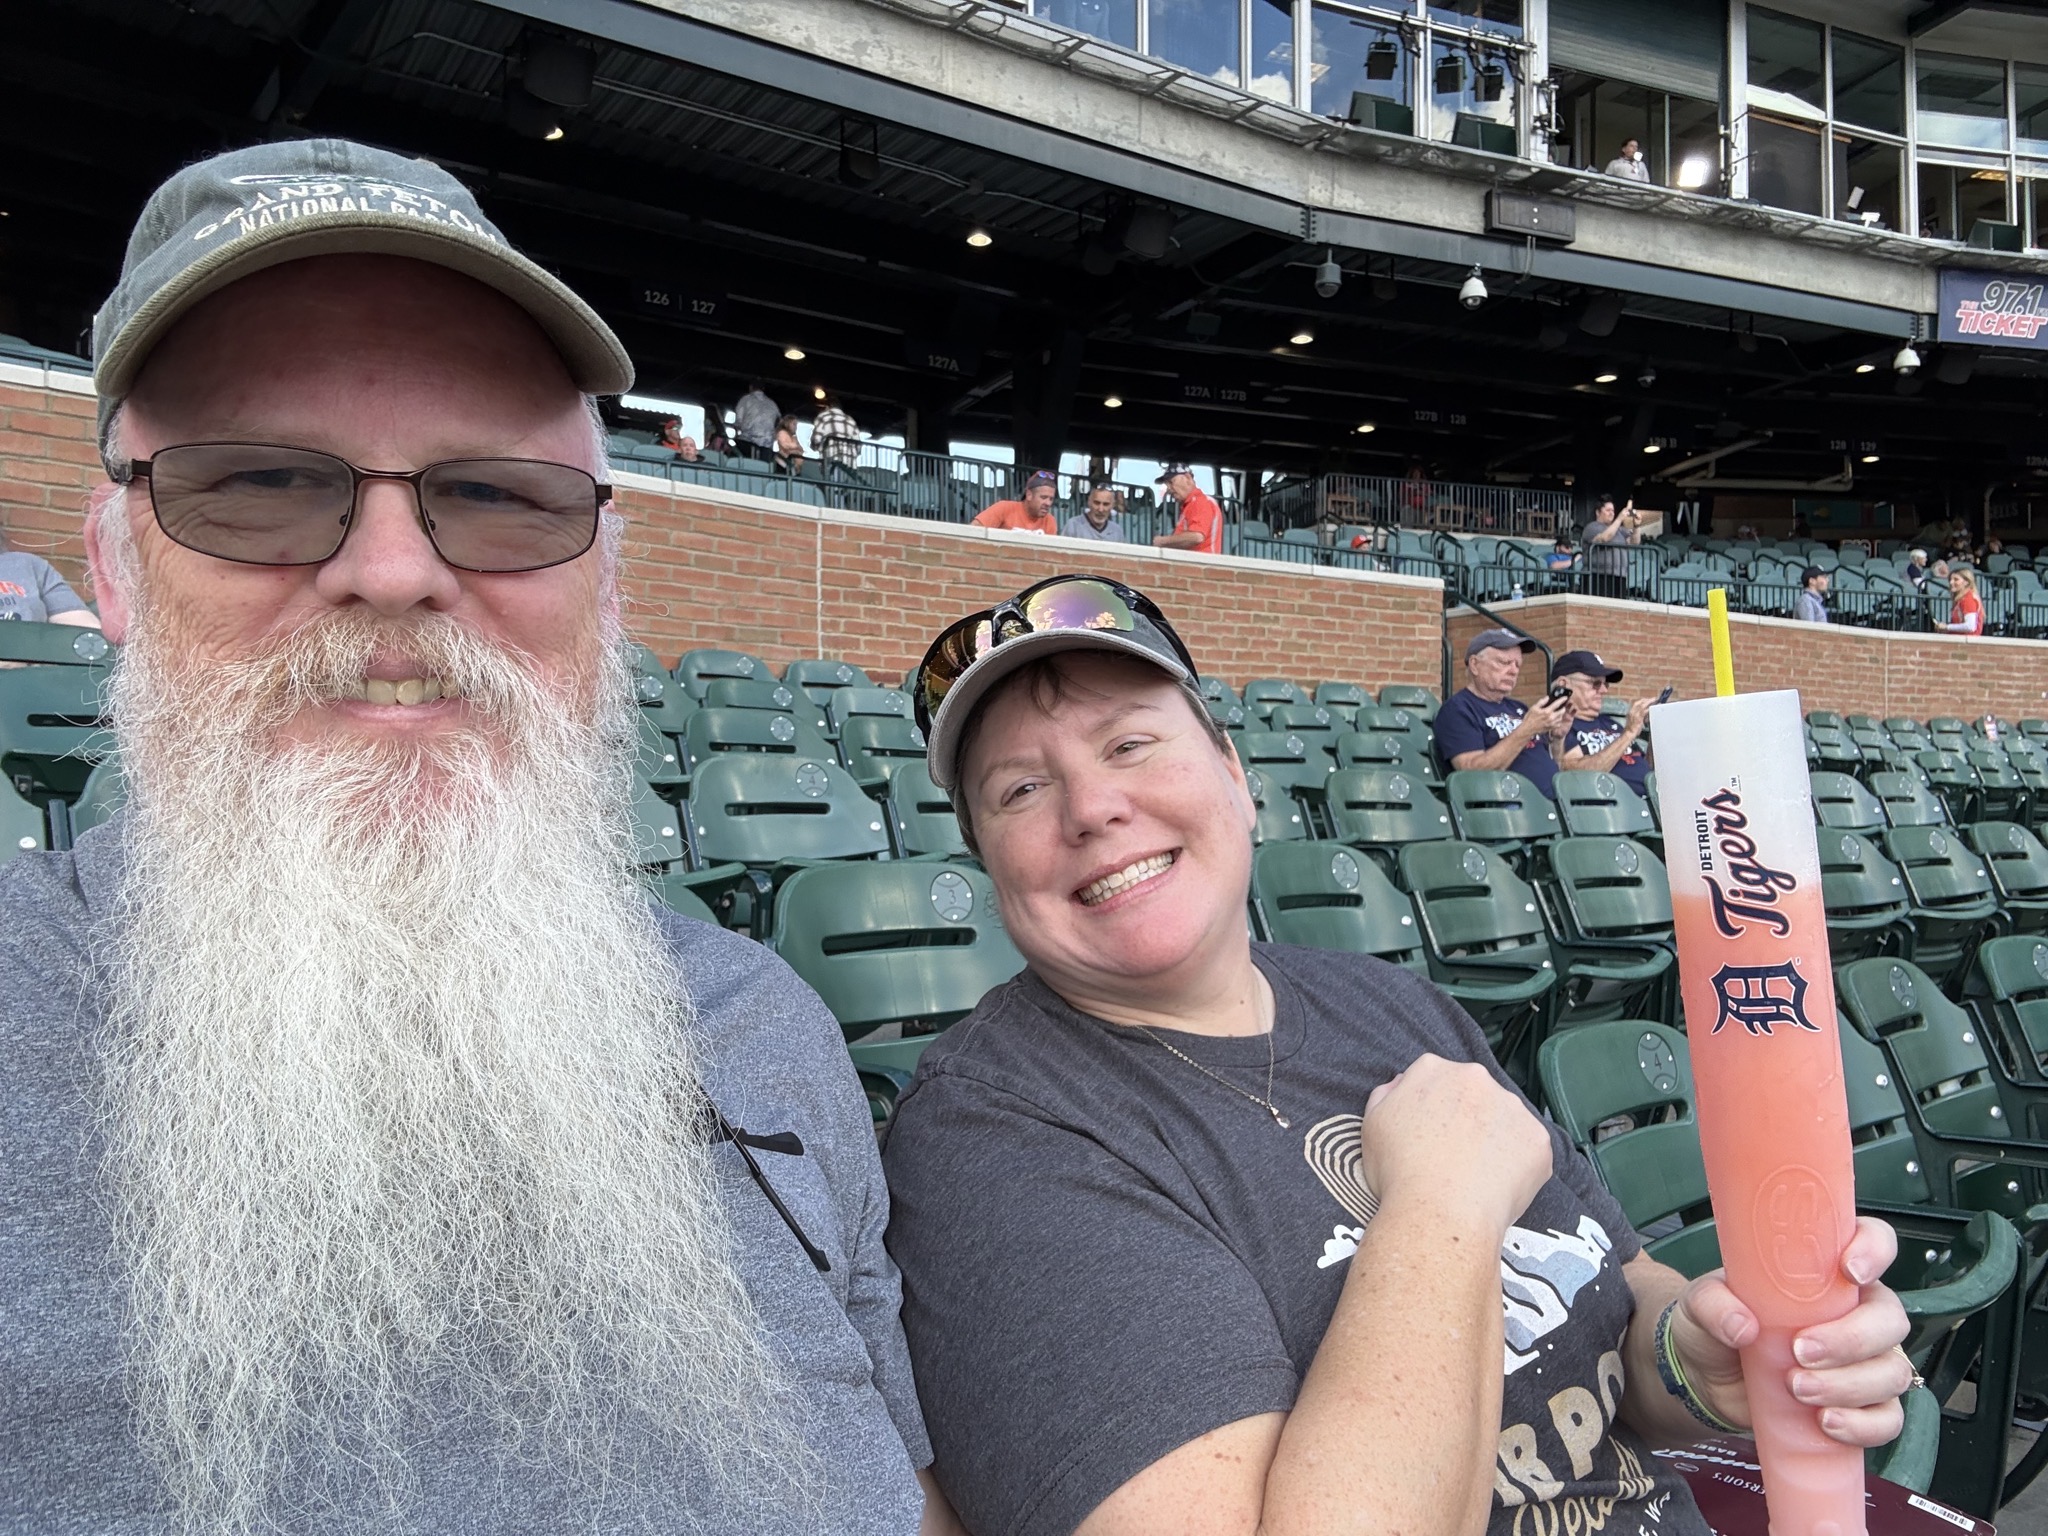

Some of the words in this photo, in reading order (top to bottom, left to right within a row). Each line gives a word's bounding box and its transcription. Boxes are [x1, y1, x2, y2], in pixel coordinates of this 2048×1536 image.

[193, 183, 343, 240] GRAND
[238, 196, 379, 236] NATIONAL
[644, 289, 670, 307] 126
[691, 299, 716, 316] 127
[1955, 309, 2048, 340] TICKET
[927, 353, 960, 373] 127A
[1184, 384, 1211, 400] 127A
[1220, 389, 1247, 403] 127B
[1694, 809, 1713, 871] DETROIT
[1700, 787, 1797, 939] Tigers
[947, 889, 957, 905] 3
[1654, 1053, 1662, 1070] 4
